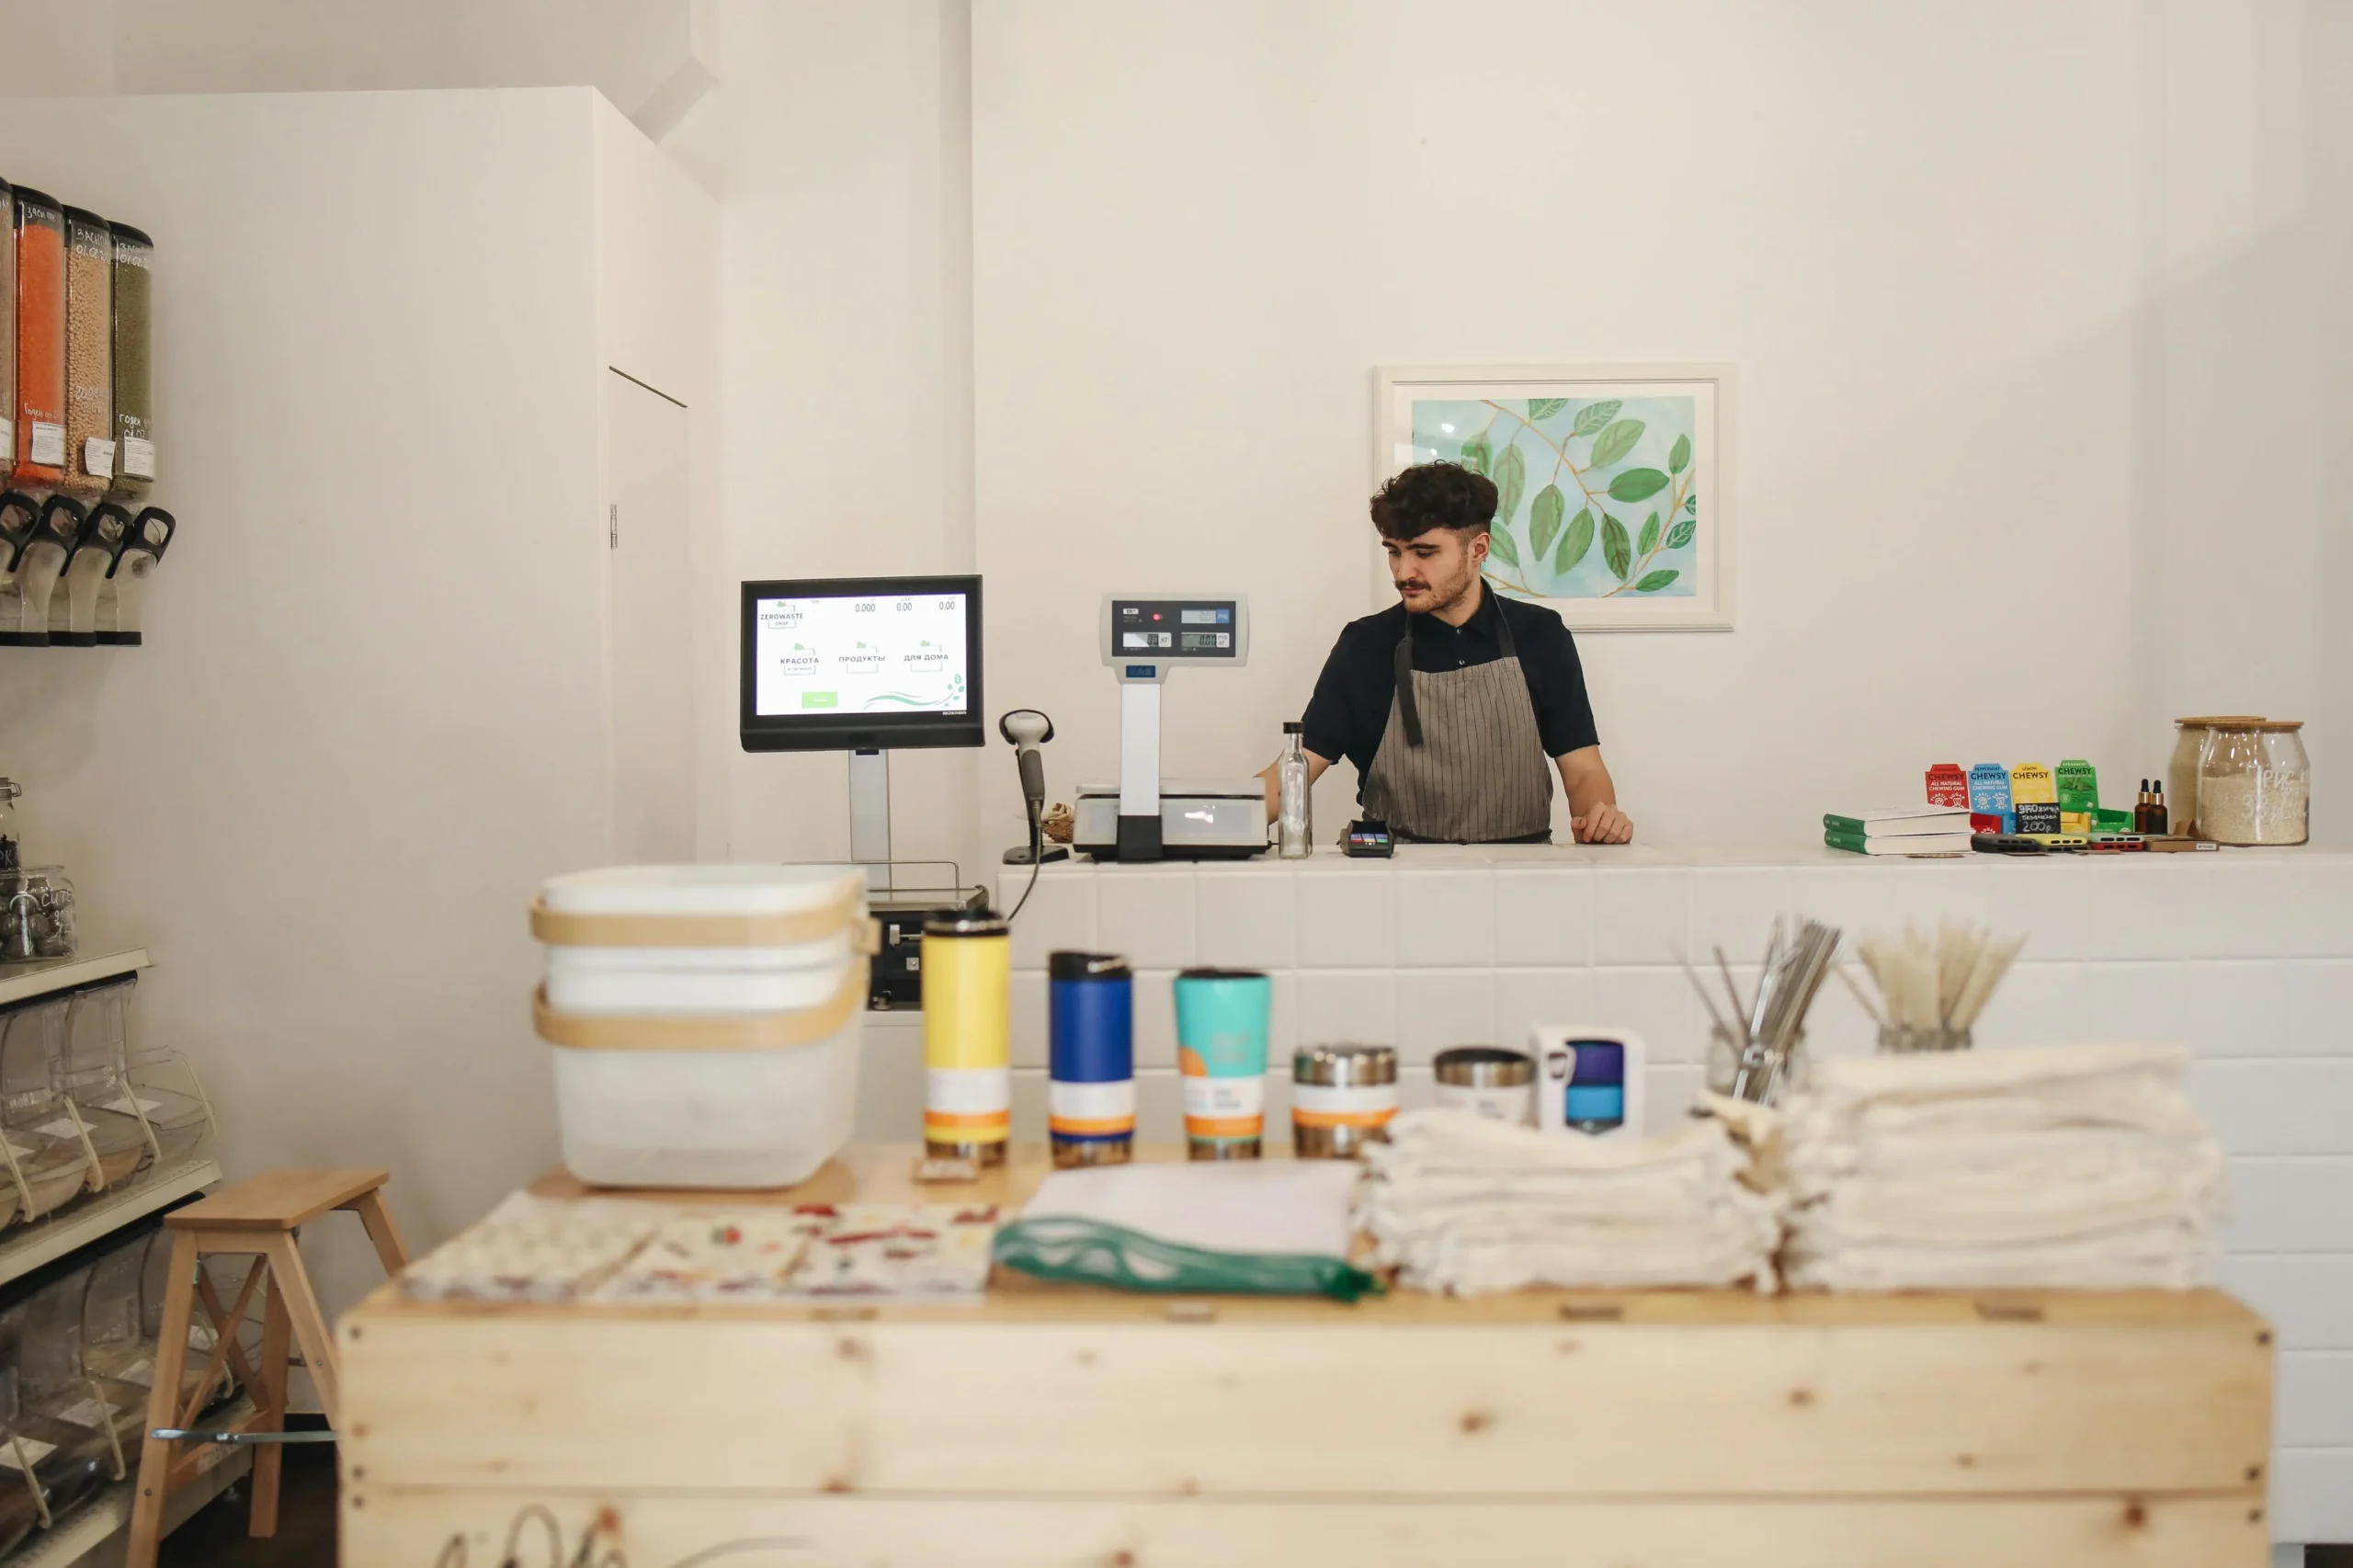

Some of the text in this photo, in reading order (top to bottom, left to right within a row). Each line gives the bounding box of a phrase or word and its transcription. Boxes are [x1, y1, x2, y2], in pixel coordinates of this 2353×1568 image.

[855, 603, 876, 613] 0.000
[896, 602, 913, 611] 0.00
[938, 601, 955, 610] 0.00
[760, 612, 804, 620] ZEROWASTE
[1970, 772, 2006, 780] CHEWSY
[2012, 771, 2049, 779] CHEWSY
